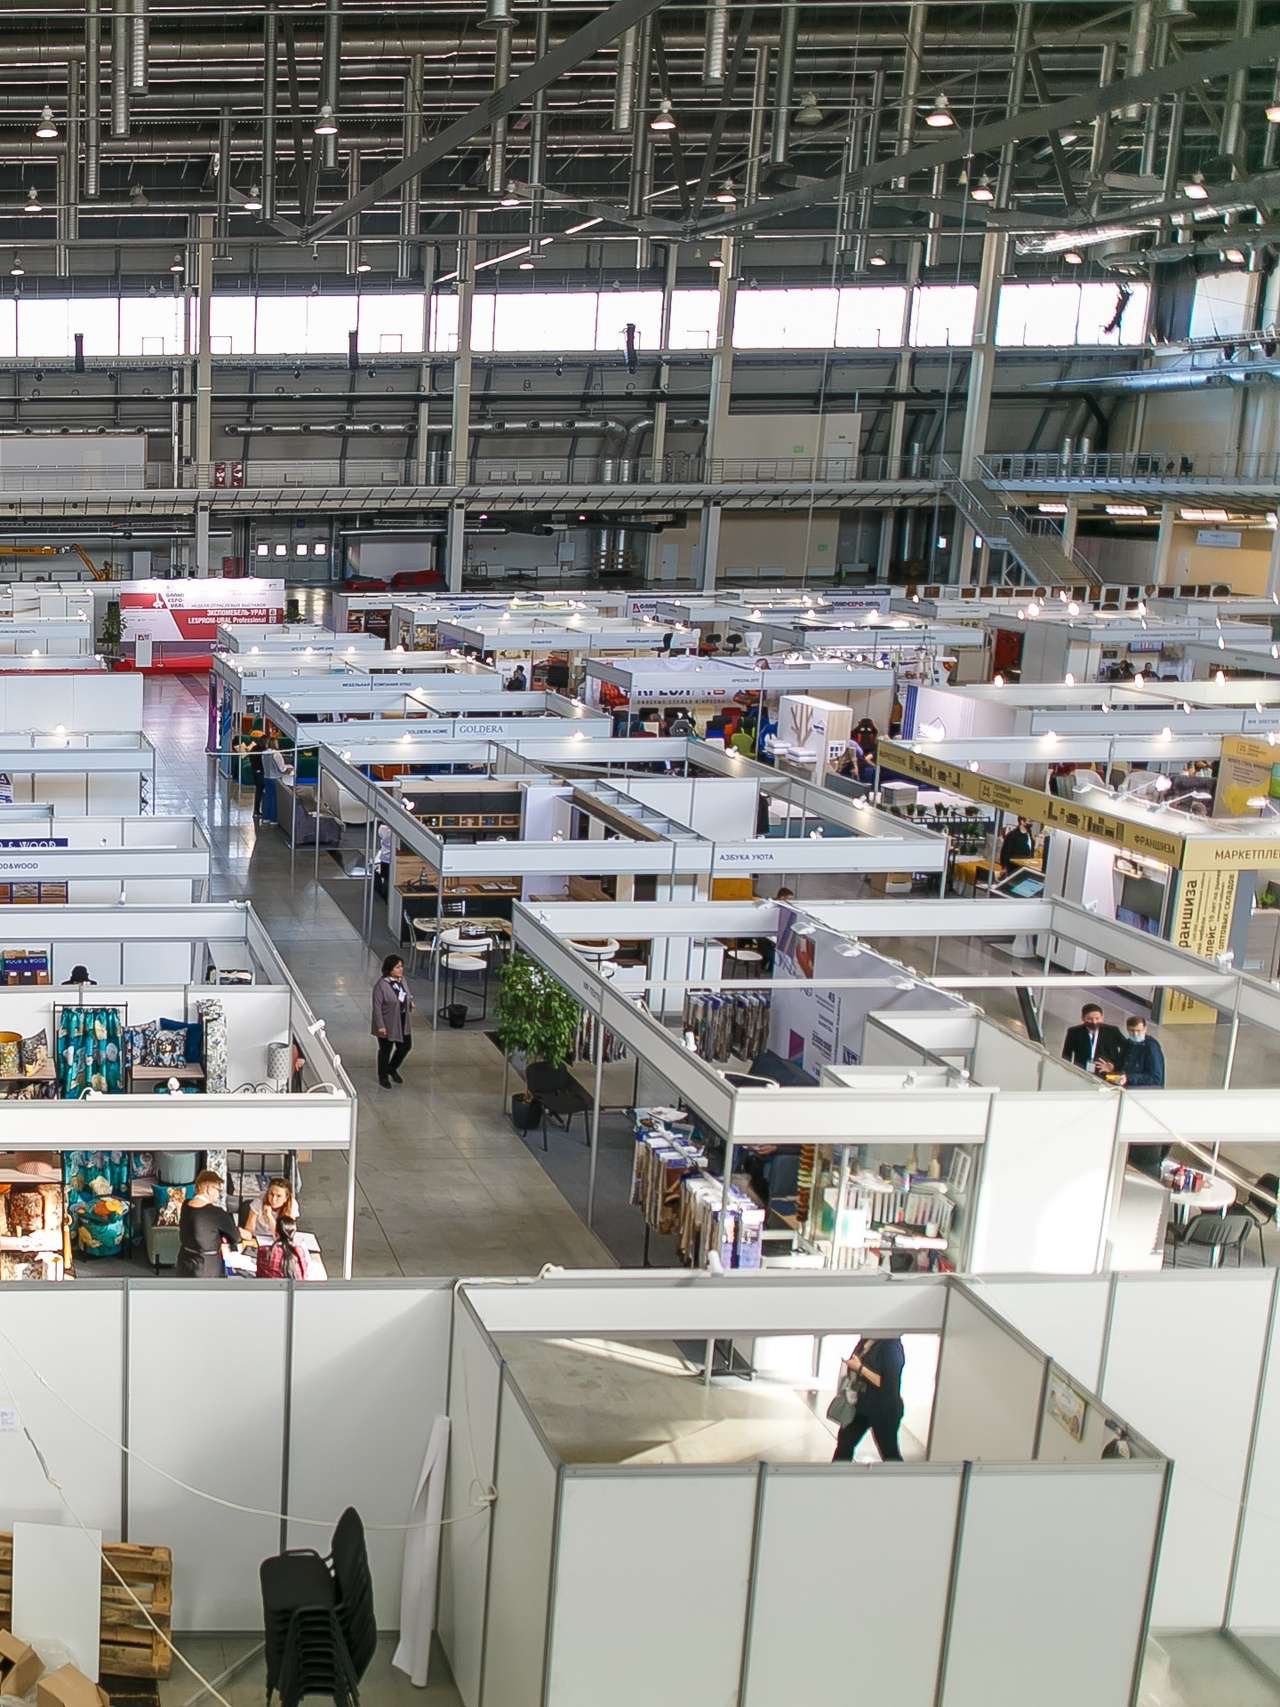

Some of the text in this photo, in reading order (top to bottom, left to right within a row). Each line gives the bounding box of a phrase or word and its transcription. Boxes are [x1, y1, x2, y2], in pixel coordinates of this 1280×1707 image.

[460, 725, 504, 734] GOLDERA
[1134, 834, 1176, 856] ФРАНШИЗА
[1215, 850, 1280, 860] МАРКЕТПЛЕ
[1178, 880, 1198, 948] раншиза
[1218, 874, 1235, 950] оптовых складов
